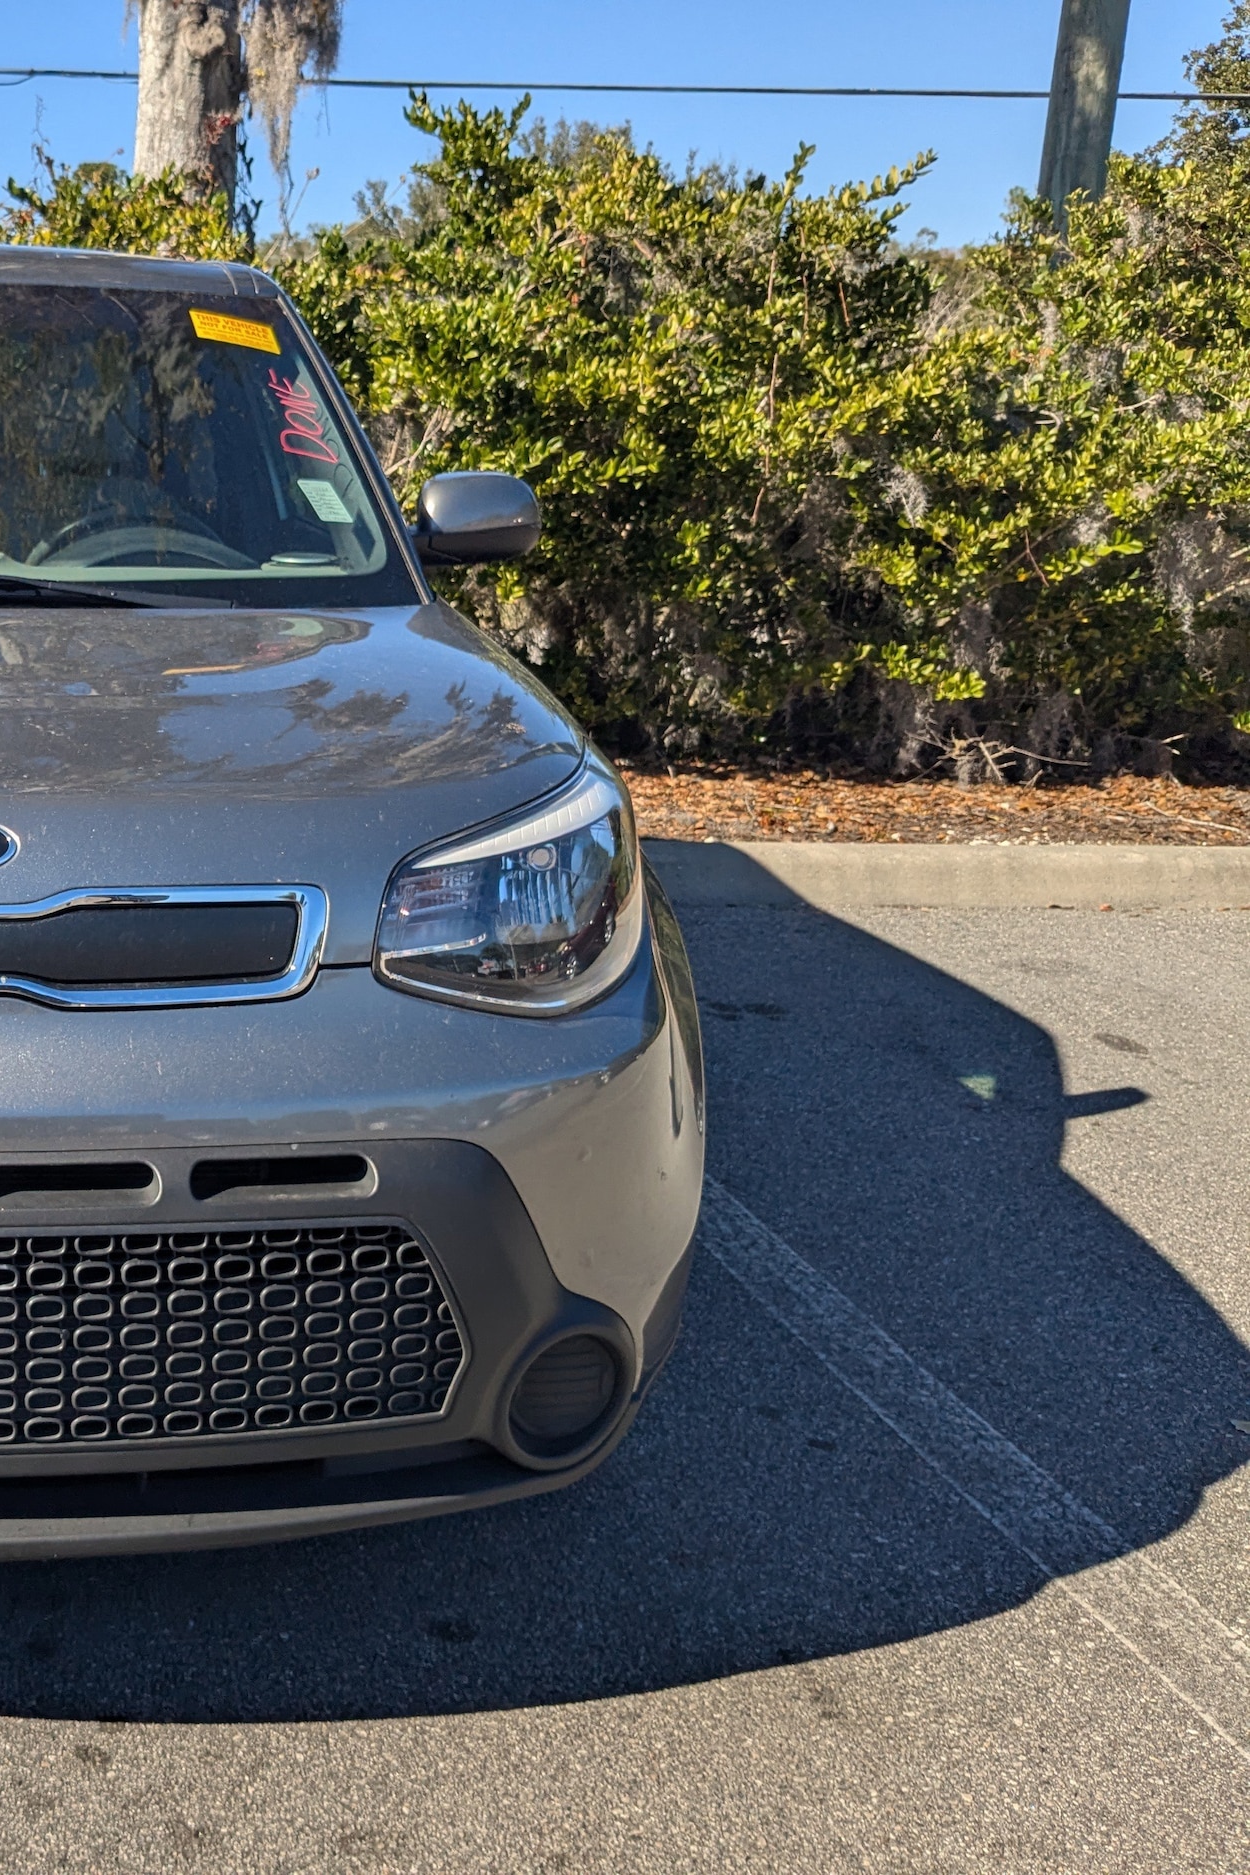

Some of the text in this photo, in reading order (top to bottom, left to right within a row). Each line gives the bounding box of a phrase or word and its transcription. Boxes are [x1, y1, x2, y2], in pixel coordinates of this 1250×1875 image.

[196, 313, 220, 324] THIS
[222, 318, 270, 335] VEHICLE
[200, 320, 219, 329] NOT
[222, 324, 242, 334] FOR
[244, 329, 270, 341] SALE
[267, 367, 339, 464] DONE
